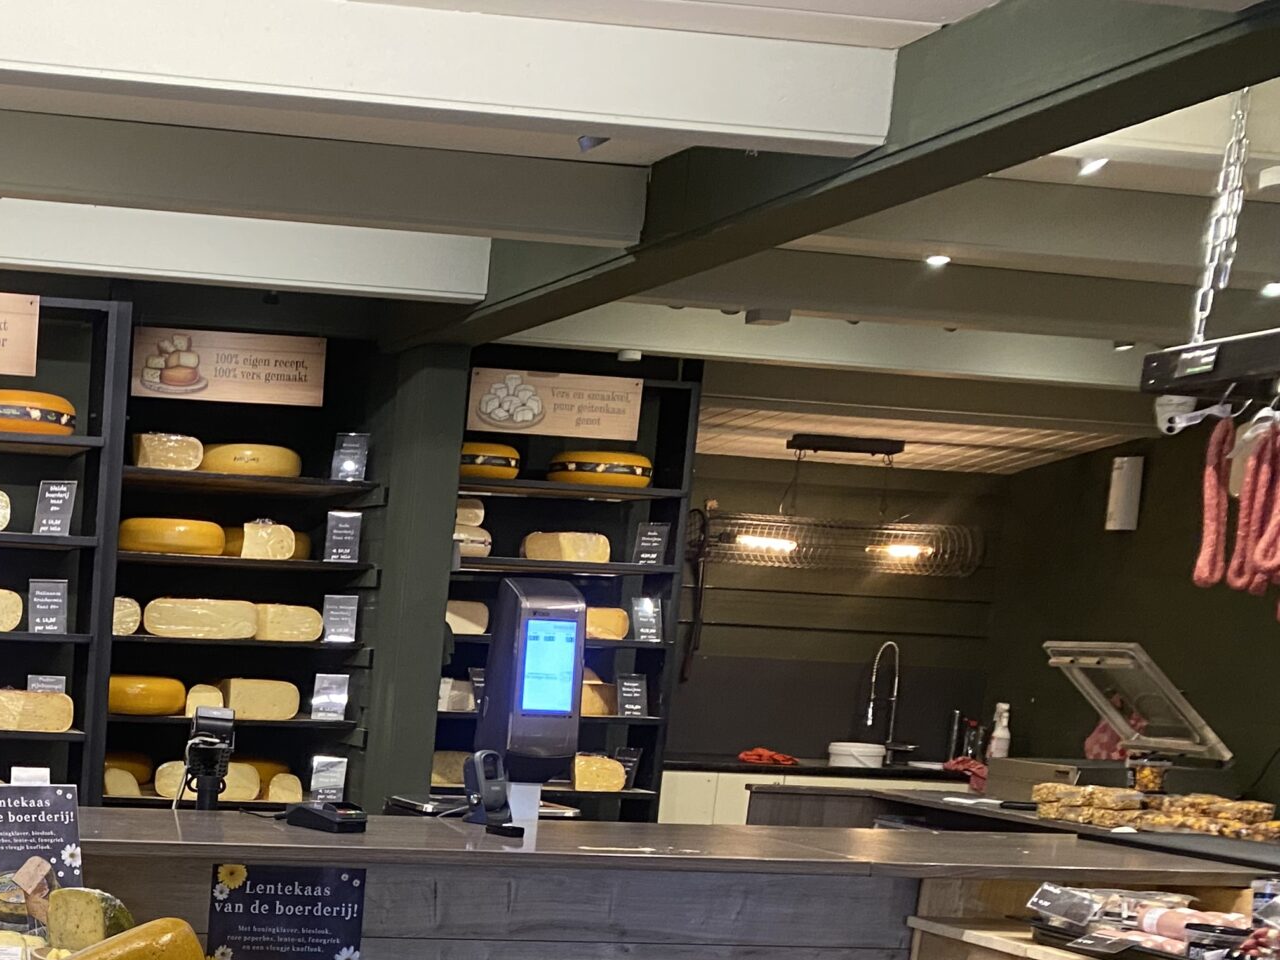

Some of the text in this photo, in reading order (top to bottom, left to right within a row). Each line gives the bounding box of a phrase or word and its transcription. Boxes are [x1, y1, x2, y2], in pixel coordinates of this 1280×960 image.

[215, 353, 308, 371] 100% eigen recept,
[213, 367, 308, 383] 100% vers gemaakt
[551, 388, 569, 398] Vers
[572, 391, 584, 399] en
[553, 402, 625, 415] puur geitenkaas
[8, 811, 74, 824] boerderij!
[245, 881, 331, 897] Lentekaas
[215, 900, 358, 920] van de boerderij!
